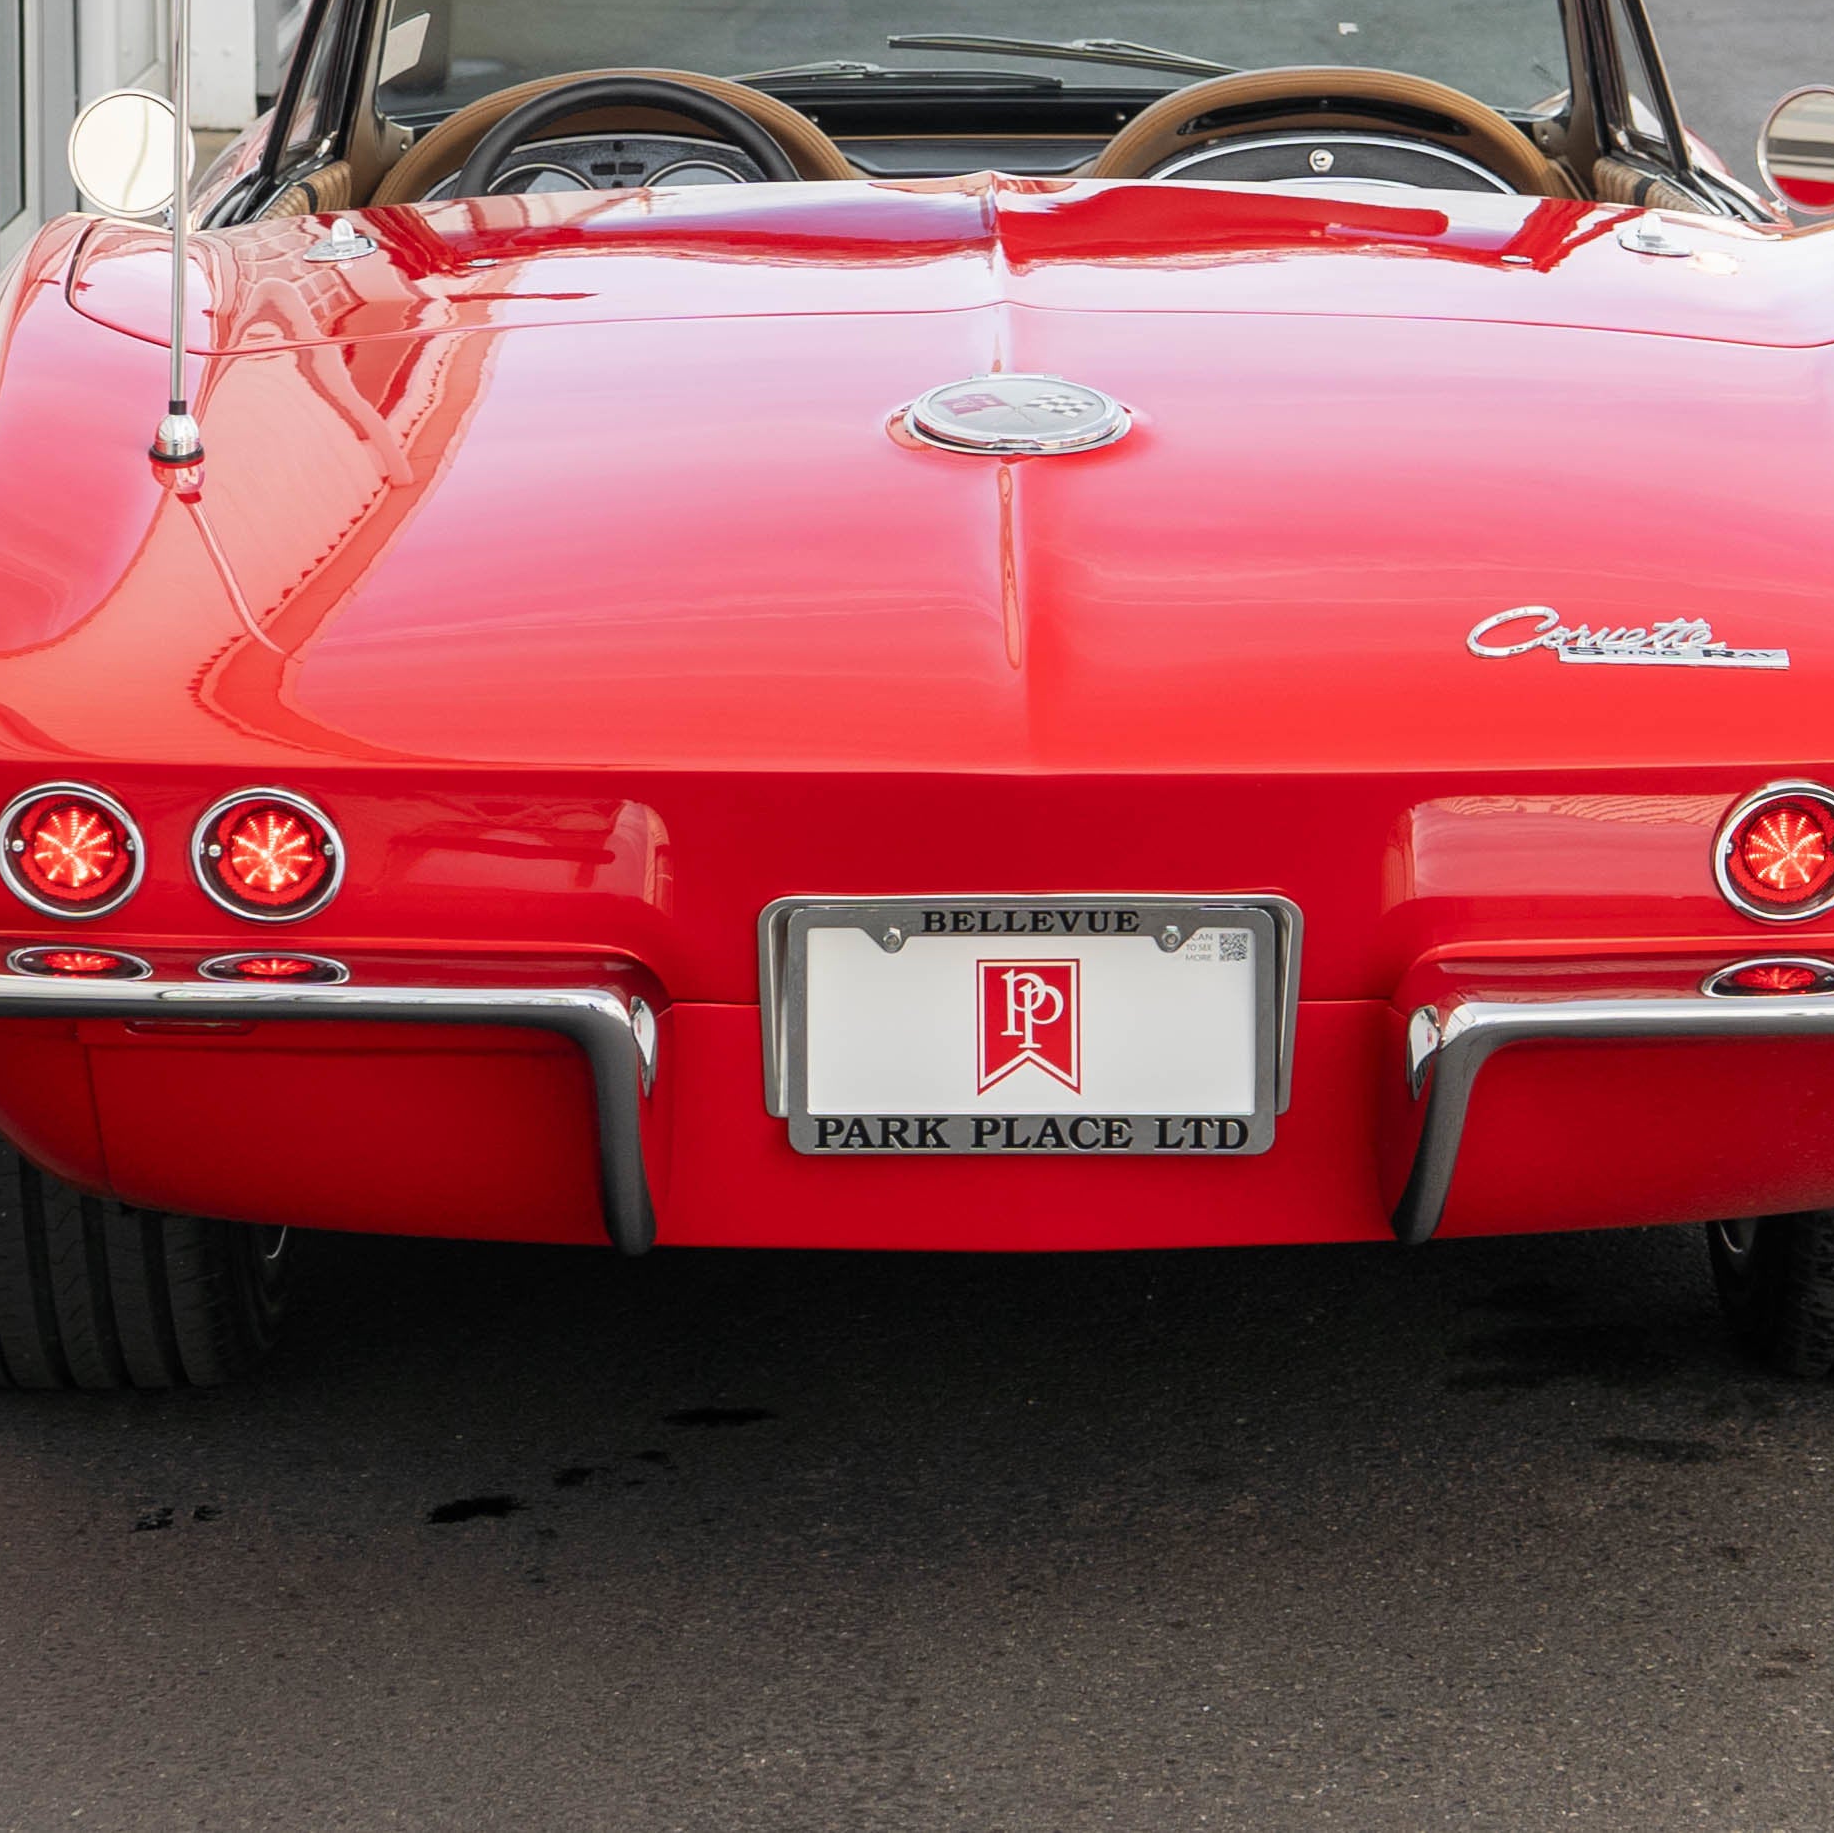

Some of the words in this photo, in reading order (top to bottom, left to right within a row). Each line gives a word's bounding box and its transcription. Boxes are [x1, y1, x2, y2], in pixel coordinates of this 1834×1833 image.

[1466, 605, 1726, 658] Corvette
[921, 910, 1140, 933] BELLEVUE
[814, 1117, 950, 1150] PARK
[970, 1117, 1134, 1150] PLACE
[1154, 1118, 1249, 1150] LTD
